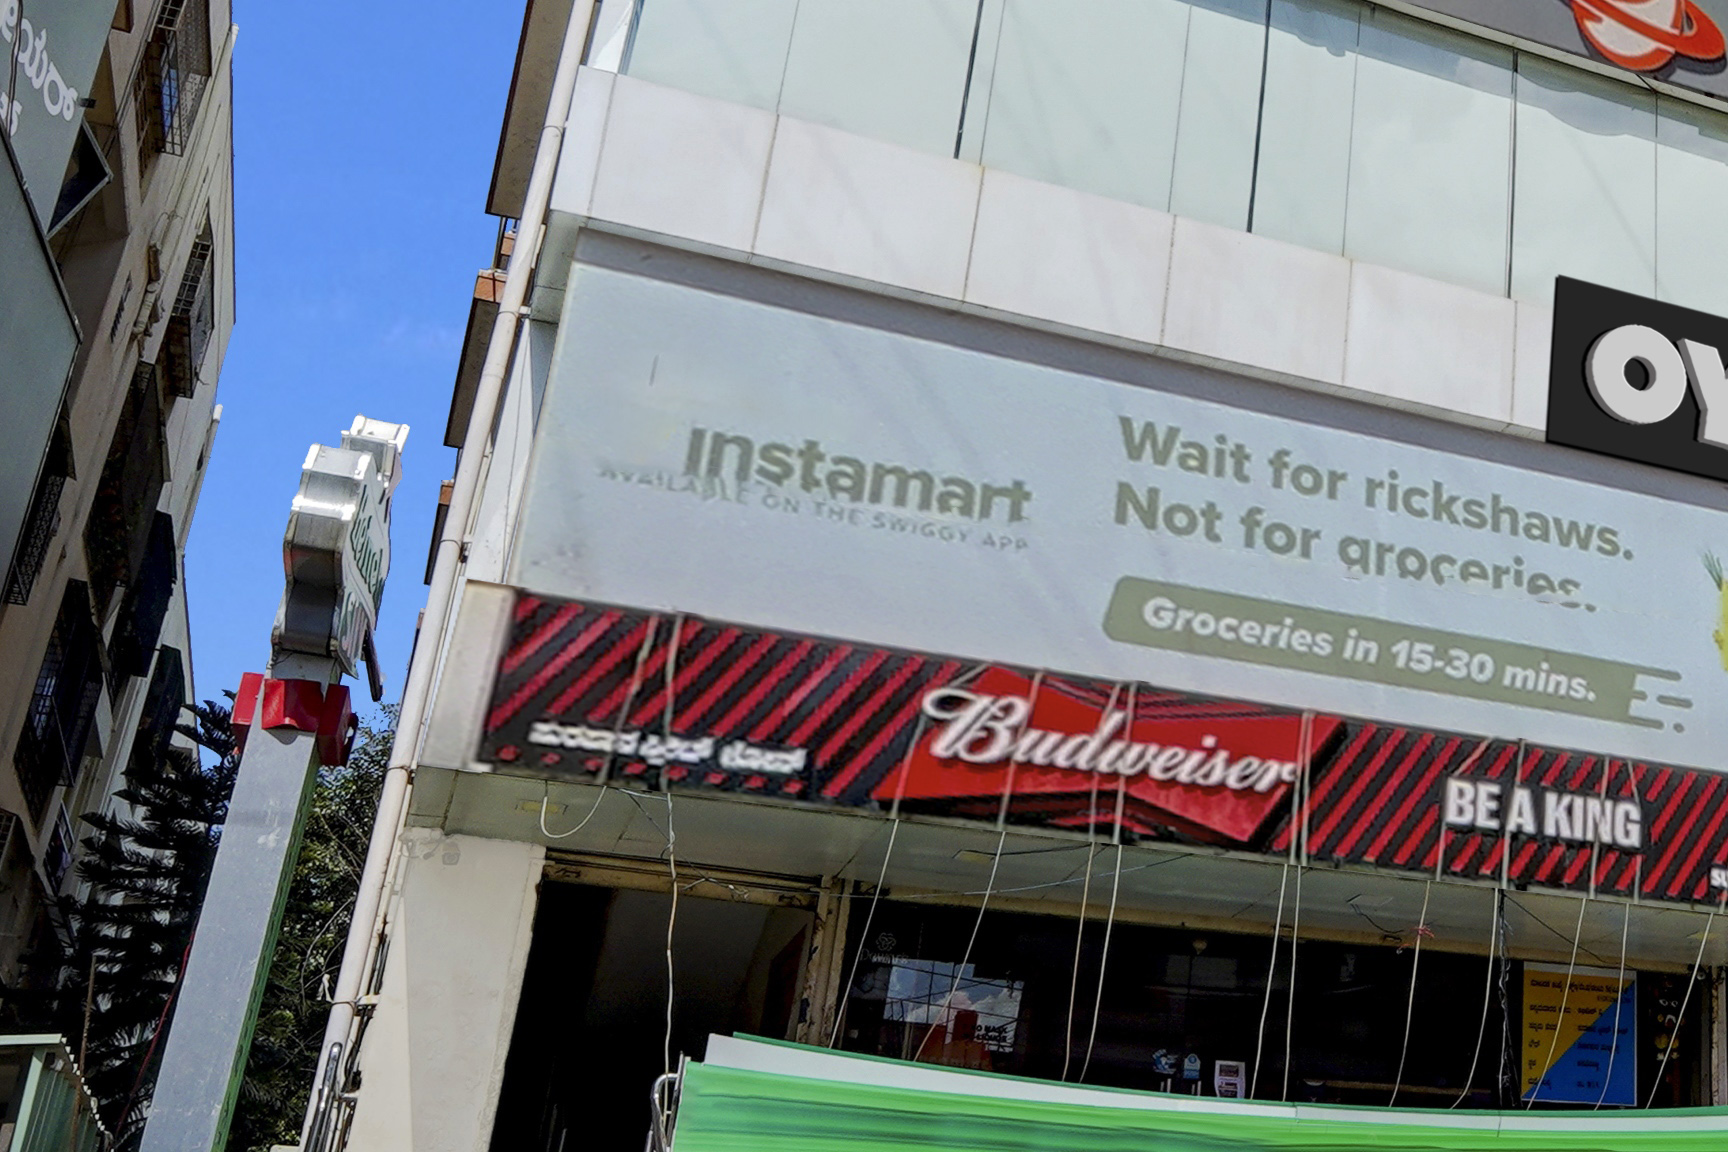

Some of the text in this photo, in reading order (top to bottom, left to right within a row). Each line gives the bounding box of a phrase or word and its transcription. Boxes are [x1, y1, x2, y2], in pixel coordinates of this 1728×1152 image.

[813, 501, 862, 526] THE
[1113, 480, 1223, 543] Not
[1239, 504, 1322, 560] for
[1118, 415, 1635, 561] Wait for rickshaws.
[1142, 596, 1597, 703] Groceries in 15-30 mins.
[922, 686, 1297, 793] Budweiser
[1445, 777, 1643, 848] BE A KING
